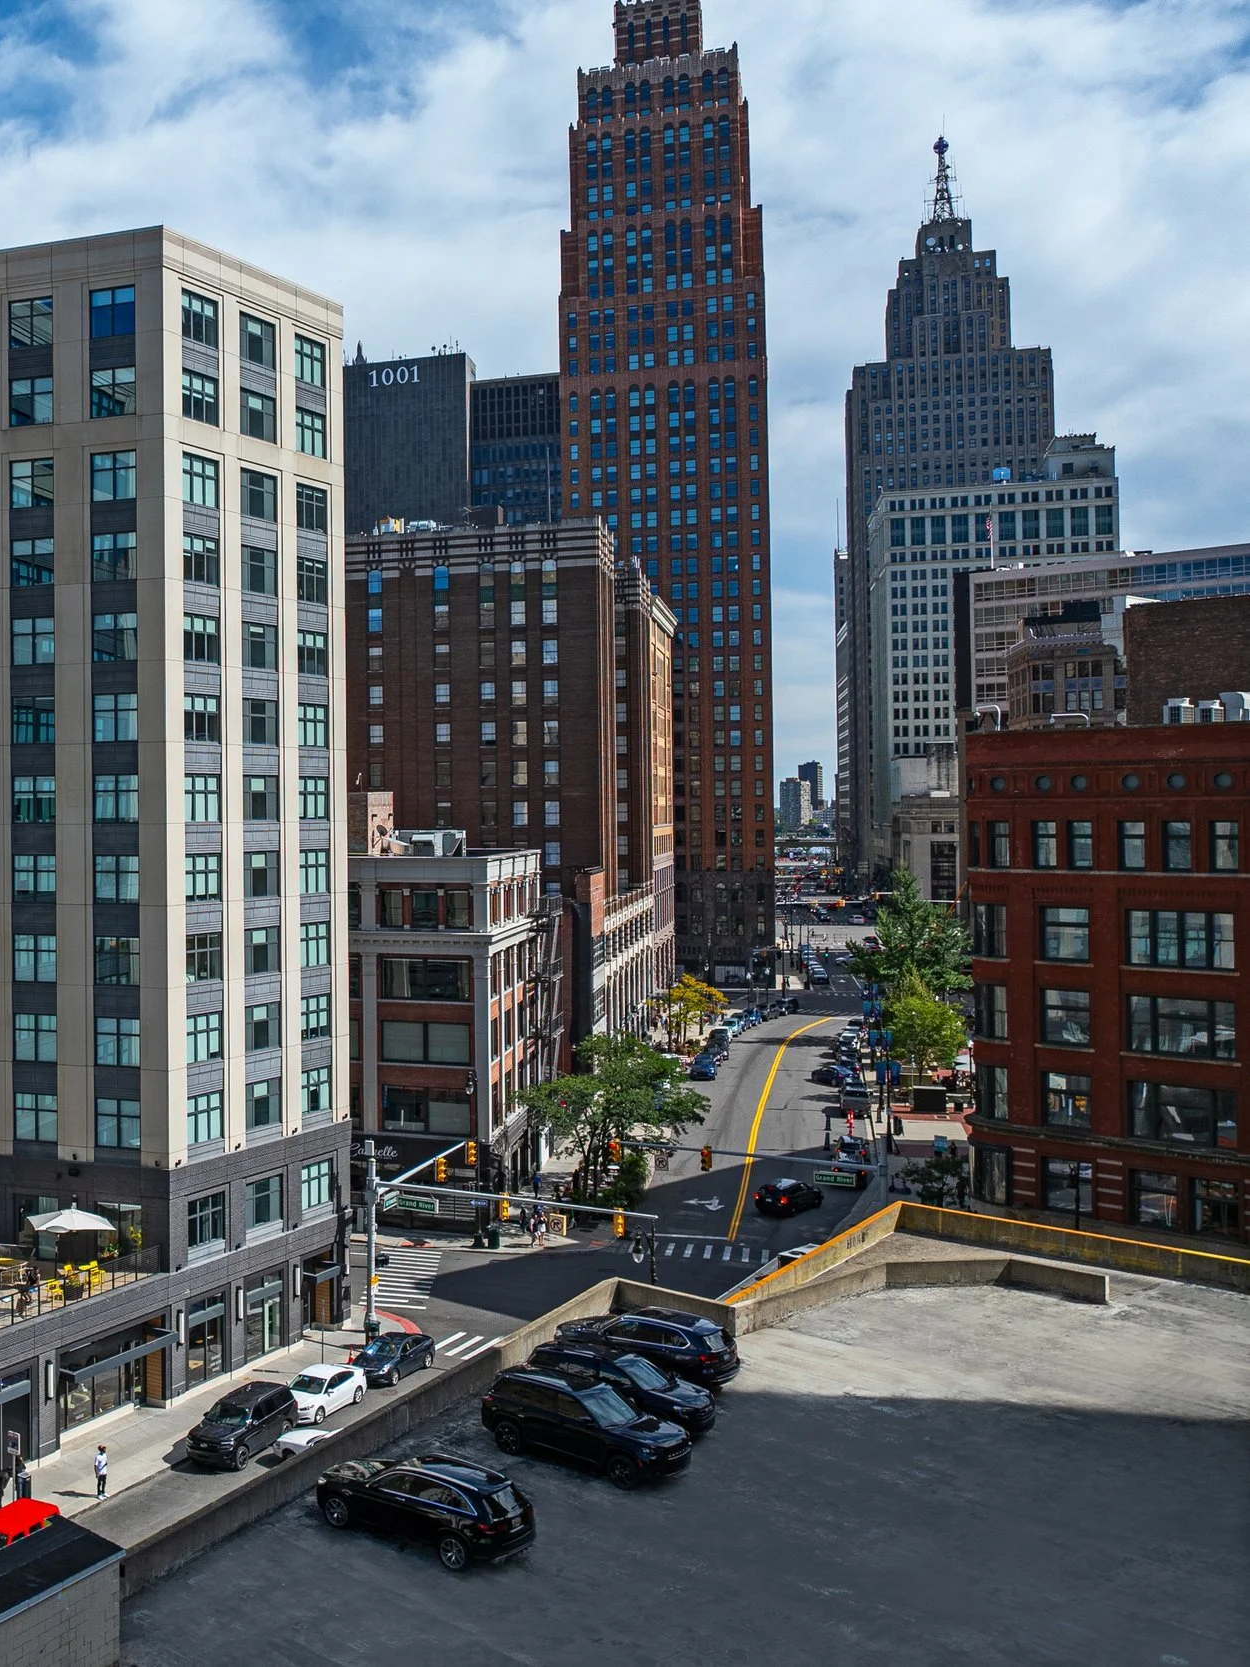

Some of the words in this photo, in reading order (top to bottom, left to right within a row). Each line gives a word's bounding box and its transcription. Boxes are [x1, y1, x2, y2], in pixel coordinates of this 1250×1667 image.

[368, 365, 421, 387] 1001
[350, 1143, 398, 1158] Caelle
[815, 1174, 835, 1182] Grand
[836, 1176, 853, 1184] River
[398, 1199, 417, 1208] Grand
[418, 1202, 435, 1210] River
